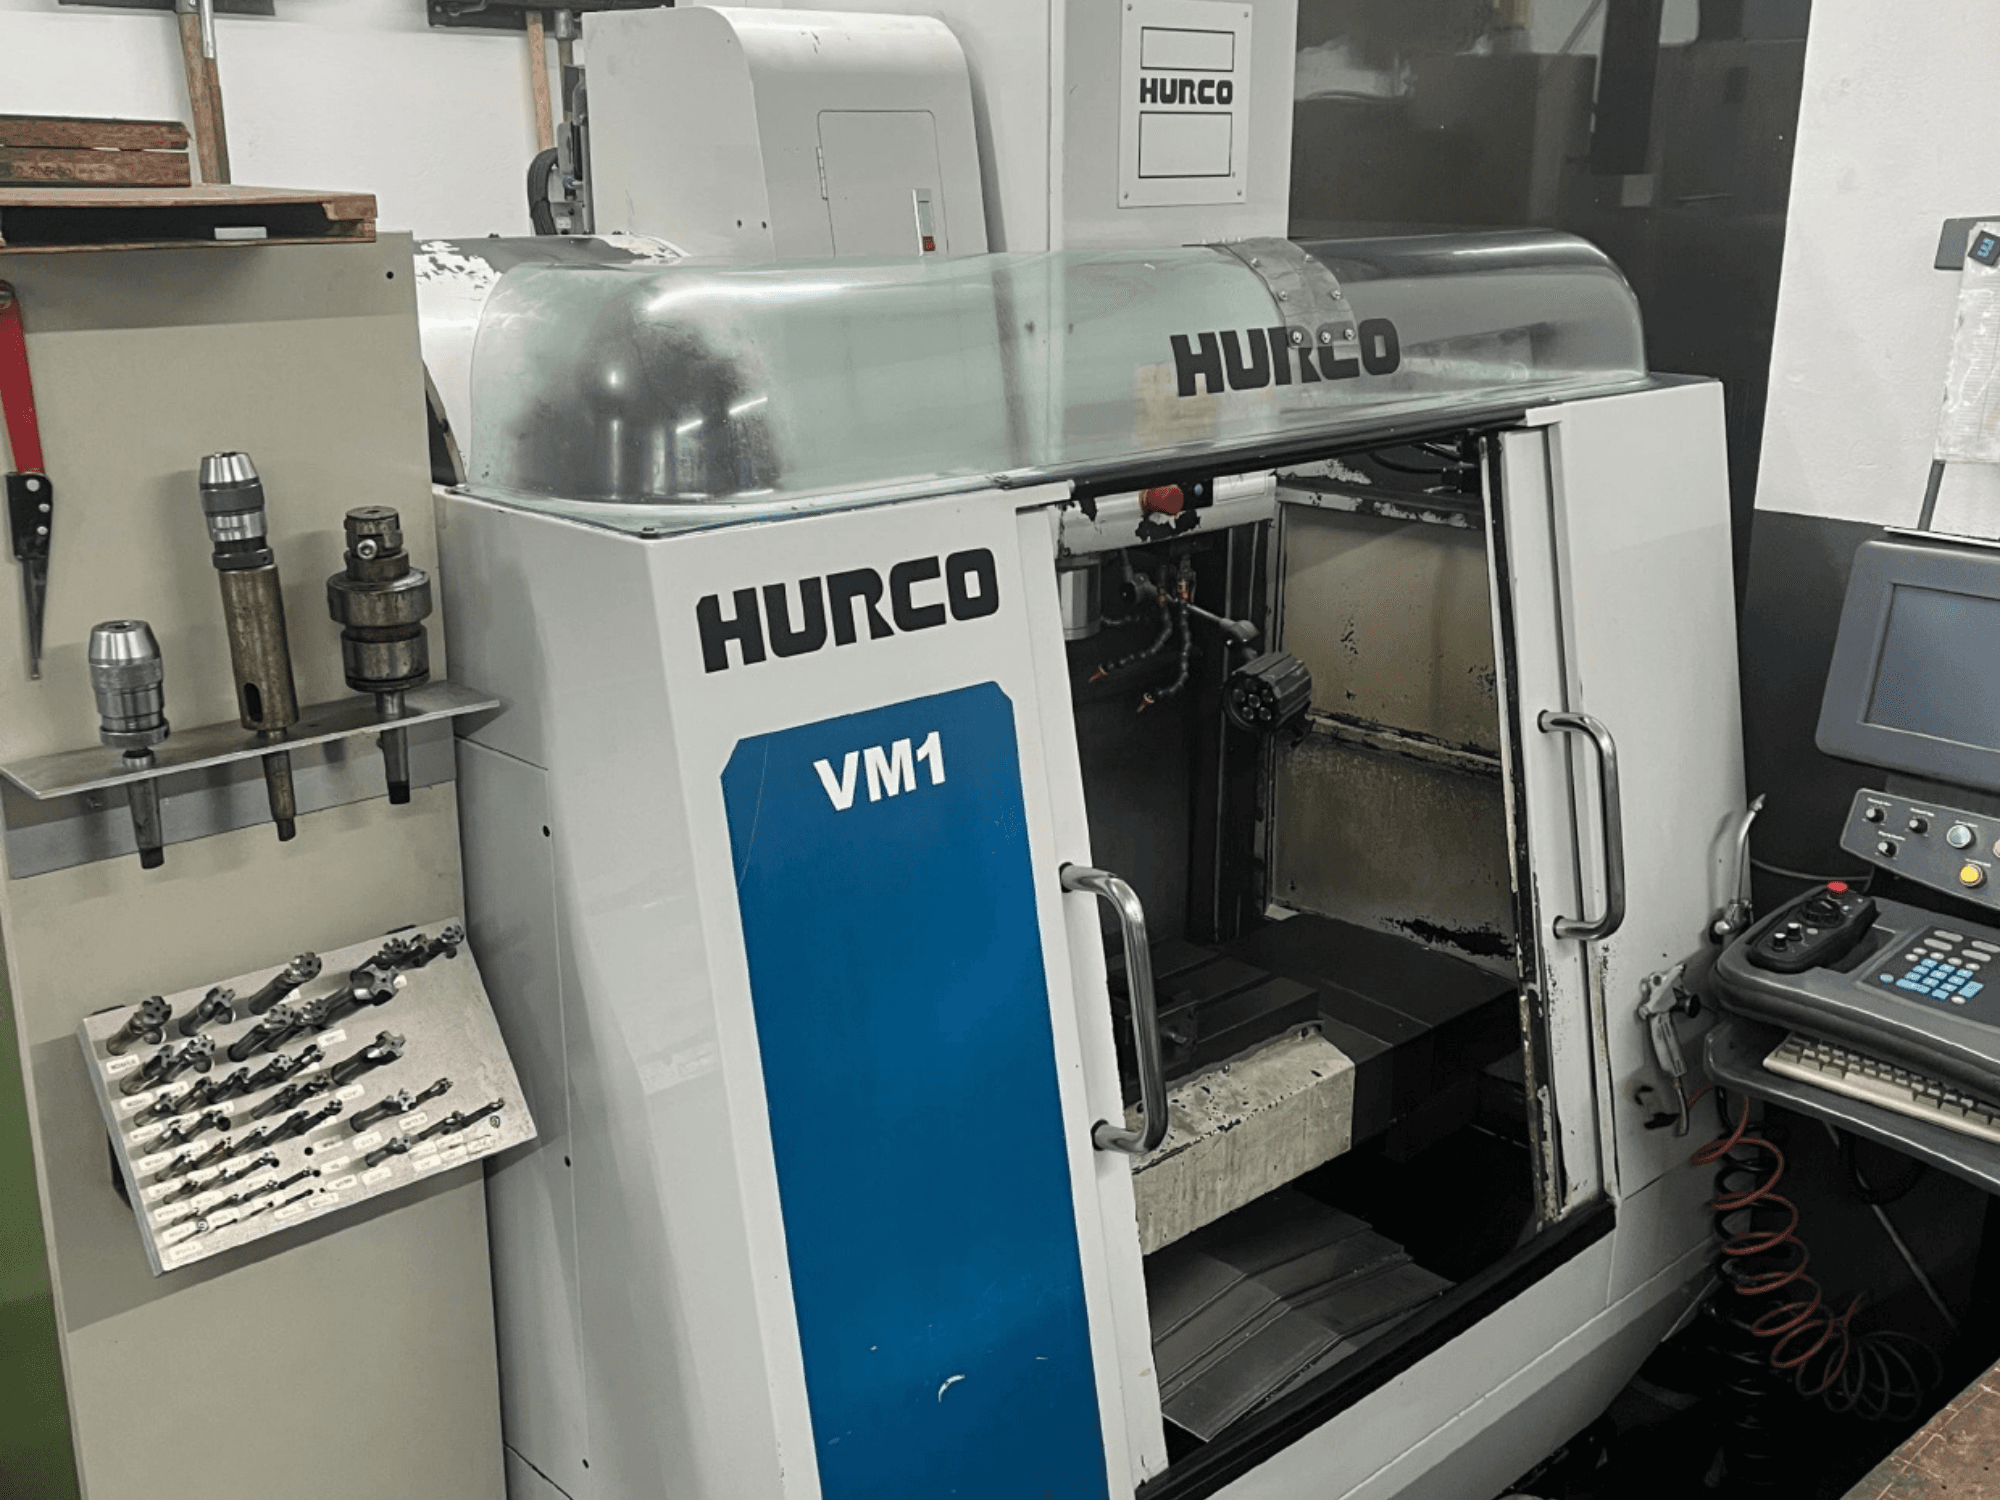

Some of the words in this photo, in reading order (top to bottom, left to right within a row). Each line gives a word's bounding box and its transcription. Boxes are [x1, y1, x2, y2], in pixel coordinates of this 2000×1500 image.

[1140, 78, 1233, 105] HURCO
[1171, 318, 1401, 397] HURCO
[697, 548, 999, 674] HURCO
[813, 731, 946, 812] VM1
